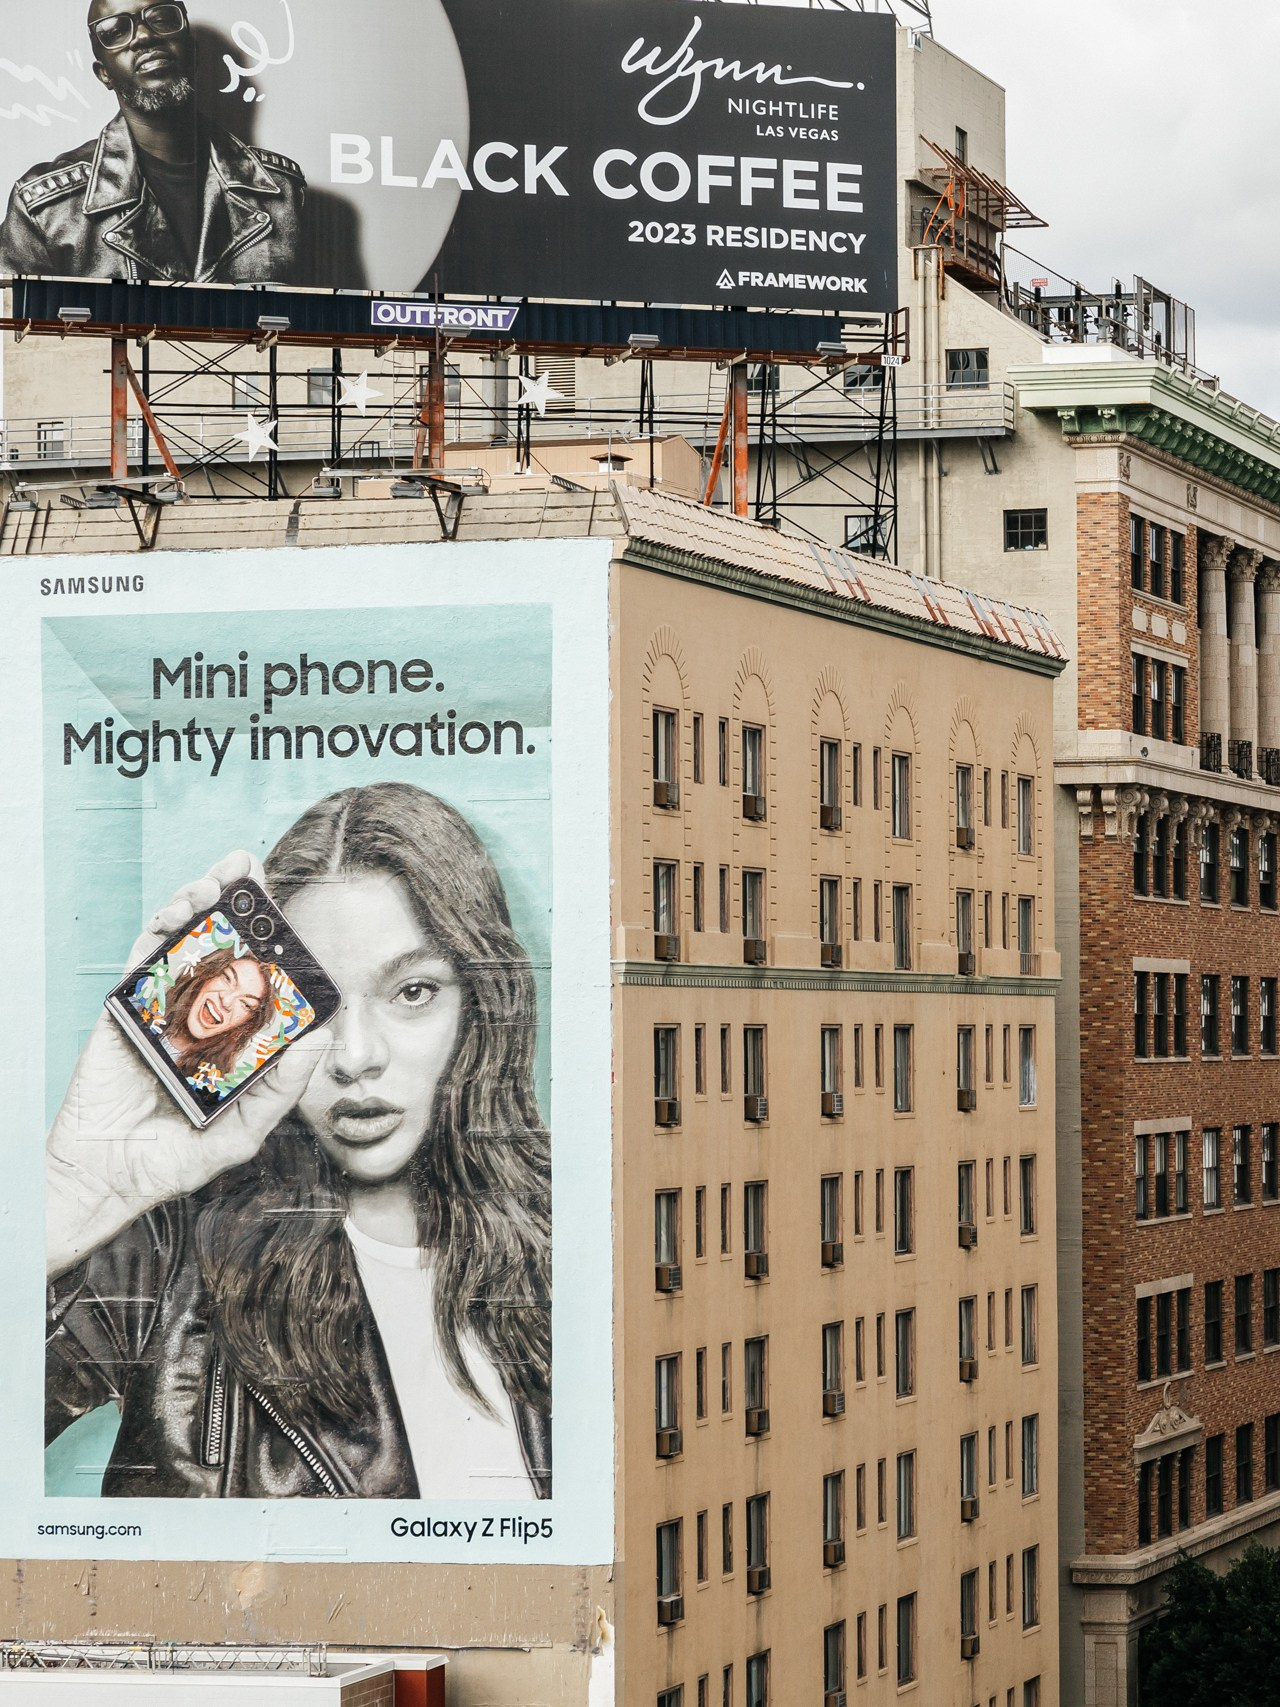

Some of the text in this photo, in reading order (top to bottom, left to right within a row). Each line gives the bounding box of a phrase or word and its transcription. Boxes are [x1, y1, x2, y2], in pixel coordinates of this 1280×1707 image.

[729, 98, 839, 122] NIGHTLIFE
[757, 125, 839, 142] LAS VEGAS
[330, 133, 864, 214] BLACK COFFEE
[628, 220, 867, 255] 2023 RESIDENCY
[738, 271, 868, 294] FRAMEWORK
[376, 304, 510, 328] OUTFRONT
[883, 356, 900, 366] 1024
[40, 575, 145, 596] SAMSUNG
[153, 651, 445, 714] Mini phone.
[63, 709, 535, 779] Mighty innovation.
[37, 1524, 142, 1540] samsung.com
[390, 1516, 553, 1544] Galaxy Z Flip5
